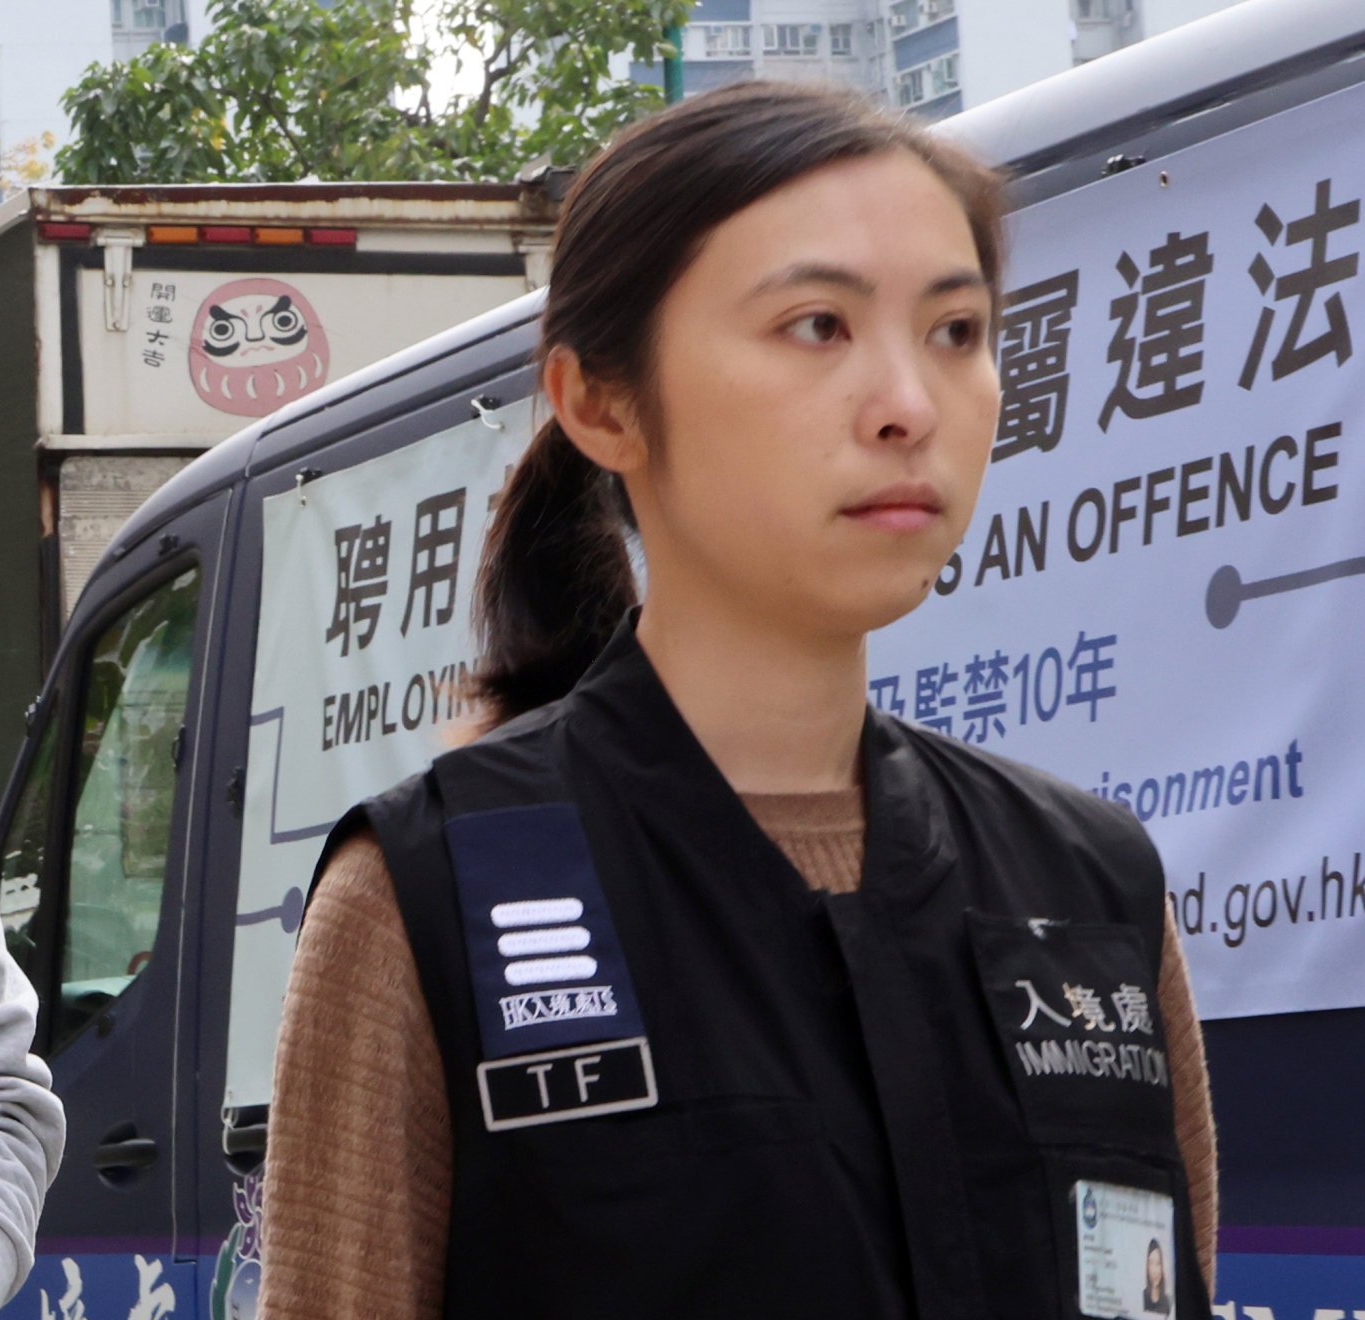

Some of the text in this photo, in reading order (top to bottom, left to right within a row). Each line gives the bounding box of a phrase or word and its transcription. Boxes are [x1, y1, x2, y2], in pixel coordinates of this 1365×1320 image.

[323, 657, 482, 751] EMPLOYIN
[974, 501, 1050, 587] AN
[1067, 421, 1343, 562] OFFENCE
[326, 465, 515, 657] 聘用
[1089, 739, 1303, 822] isonment
[1015, 979, 1154, 1034] 入境處
[1015, 1039, 1168, 1089] IMMIGRATION
